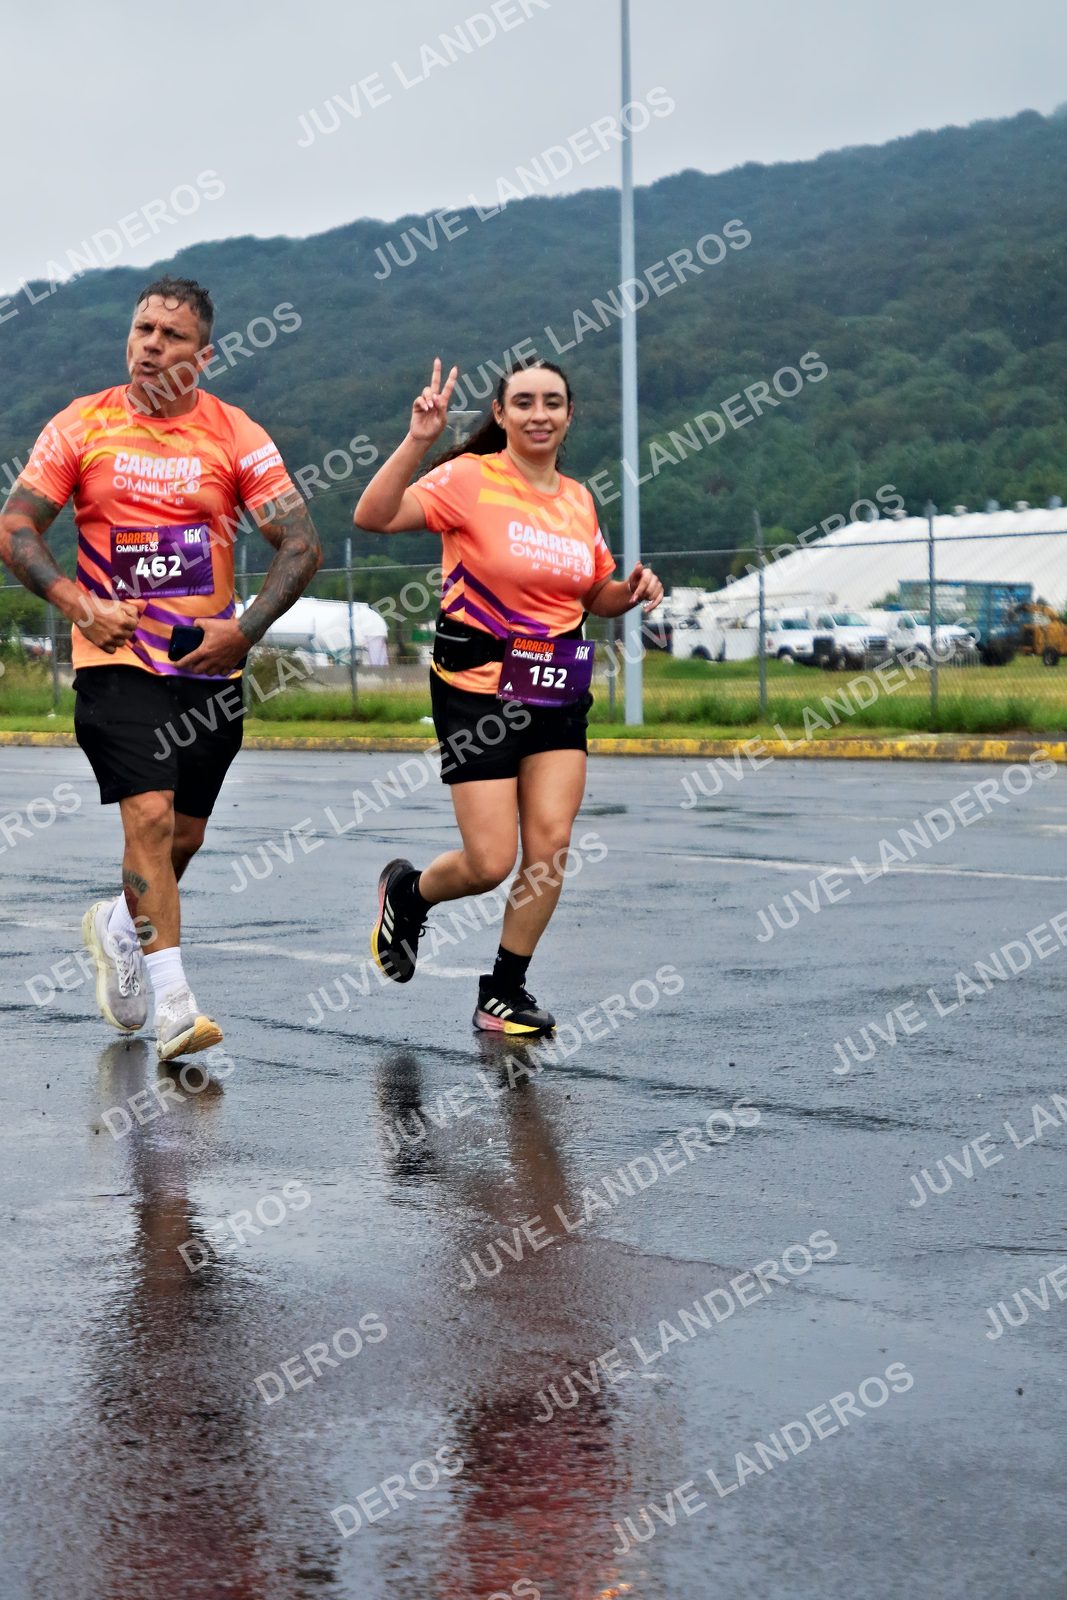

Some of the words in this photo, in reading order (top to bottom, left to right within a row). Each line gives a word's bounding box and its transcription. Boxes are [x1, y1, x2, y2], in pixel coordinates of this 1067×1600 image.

[113, 452, 201, 479] CARRERA
[116, 532, 159, 544] CARRERA
[508, 521, 592, 558] CARRERA
[135, 555, 182, 578] 462
[513, 638, 555, 652] CARRERA
[529, 665, 568, 689] 152
